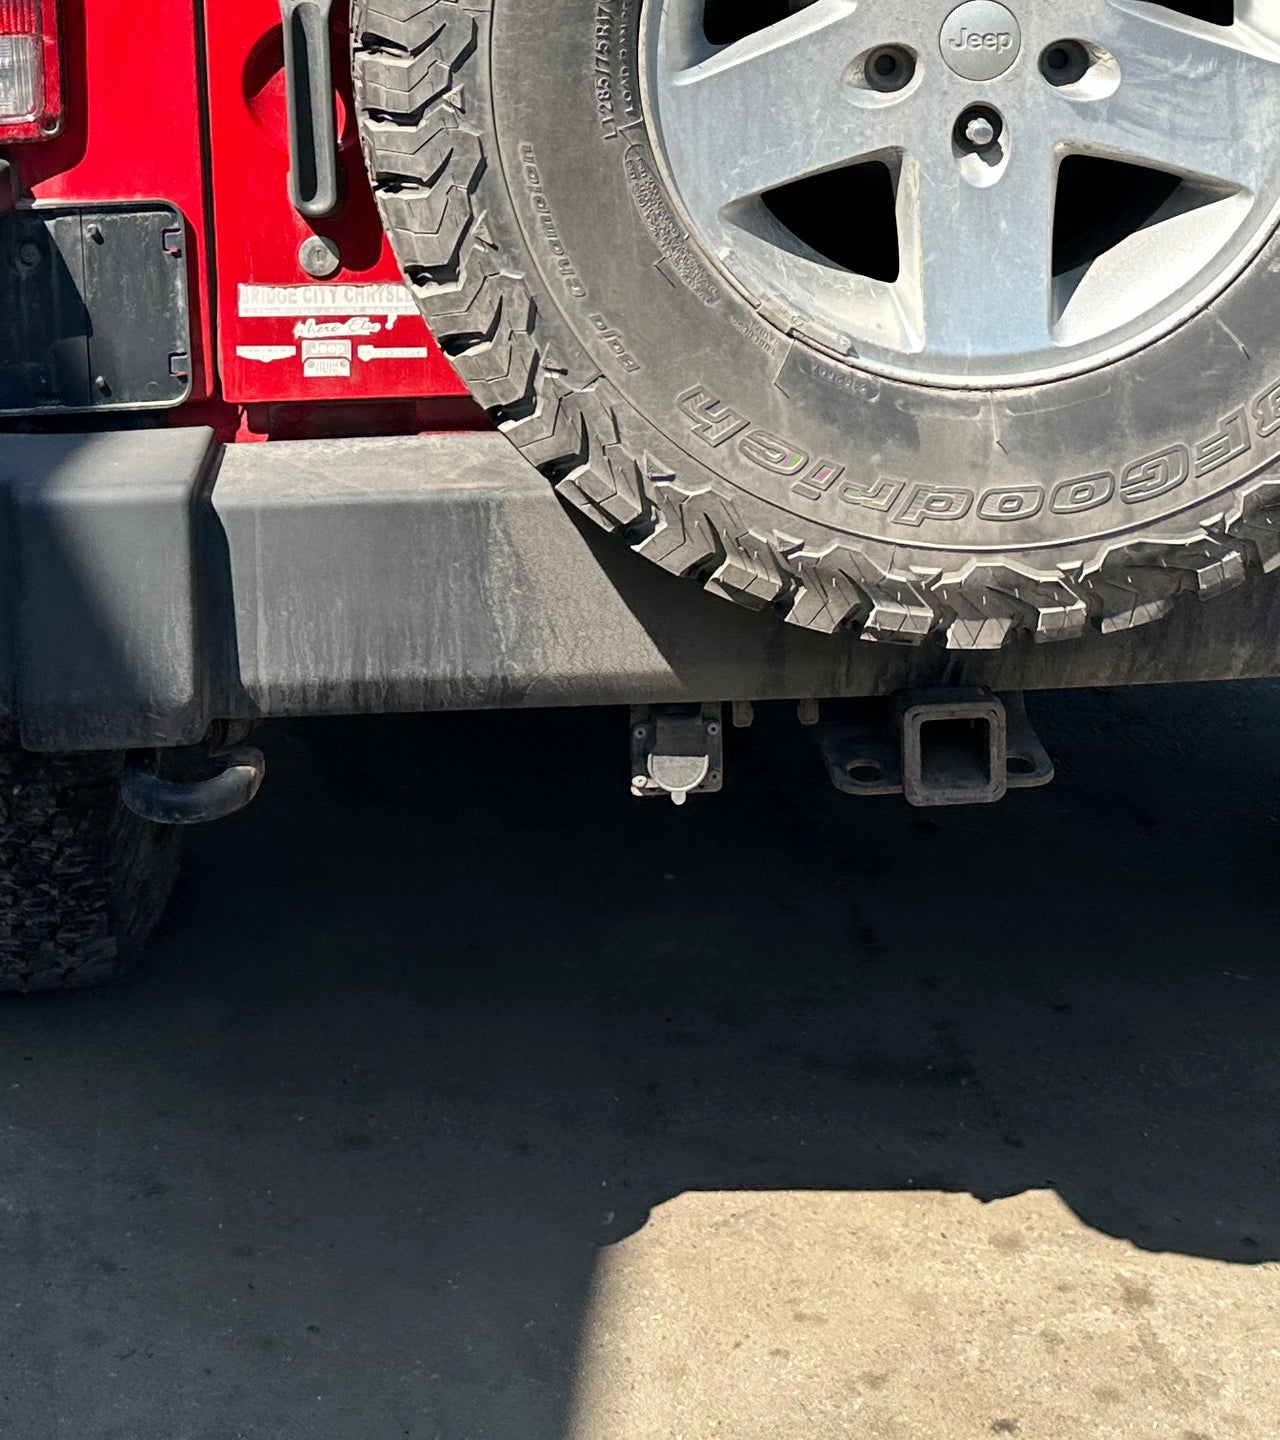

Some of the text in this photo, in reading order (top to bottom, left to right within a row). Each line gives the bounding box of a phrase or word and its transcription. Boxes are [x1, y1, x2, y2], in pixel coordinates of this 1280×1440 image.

[948, 27, 1013, 55] Jeep
[518, 141, 587, 298] Champion
[242, 287, 297, 304] BRIDGE
[303, 286, 338, 304] CITY
[310, 343, 346, 355] Jeep
[588, 313, 641, 373] Baja
